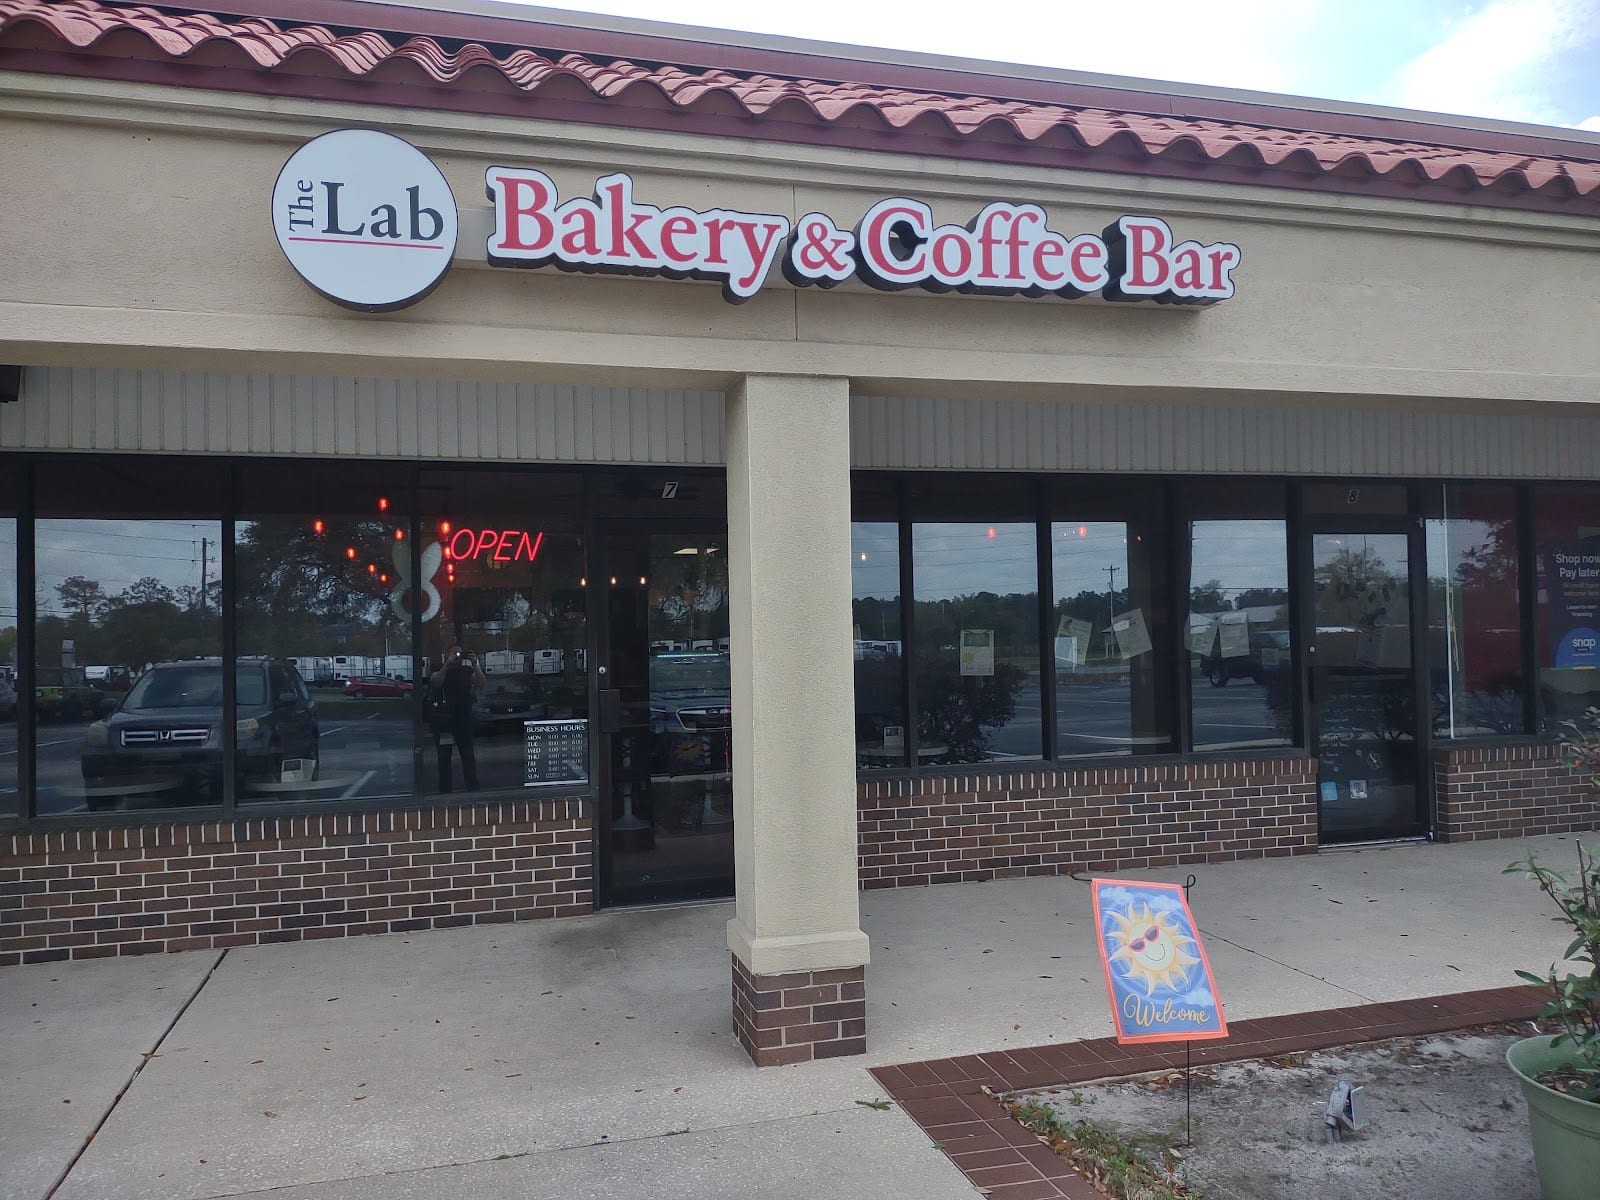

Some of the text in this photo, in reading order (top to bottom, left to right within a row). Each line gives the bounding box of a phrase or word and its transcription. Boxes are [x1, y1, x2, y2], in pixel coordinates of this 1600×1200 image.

[288, 179, 314, 232] The
[320, 180, 444, 241] Lab
[495, 176, 1233, 291] Bakery & Coffee Bar
[665, 483, 676, 496] 7
[450, 528, 543, 561] OPEN
[1556, 553, 1581, 566] Shop
[1559, 568, 1577, 580] Pay
[1572, 638, 1596, 650] snap
[1123, 993, 1211, 1027] Welcome
